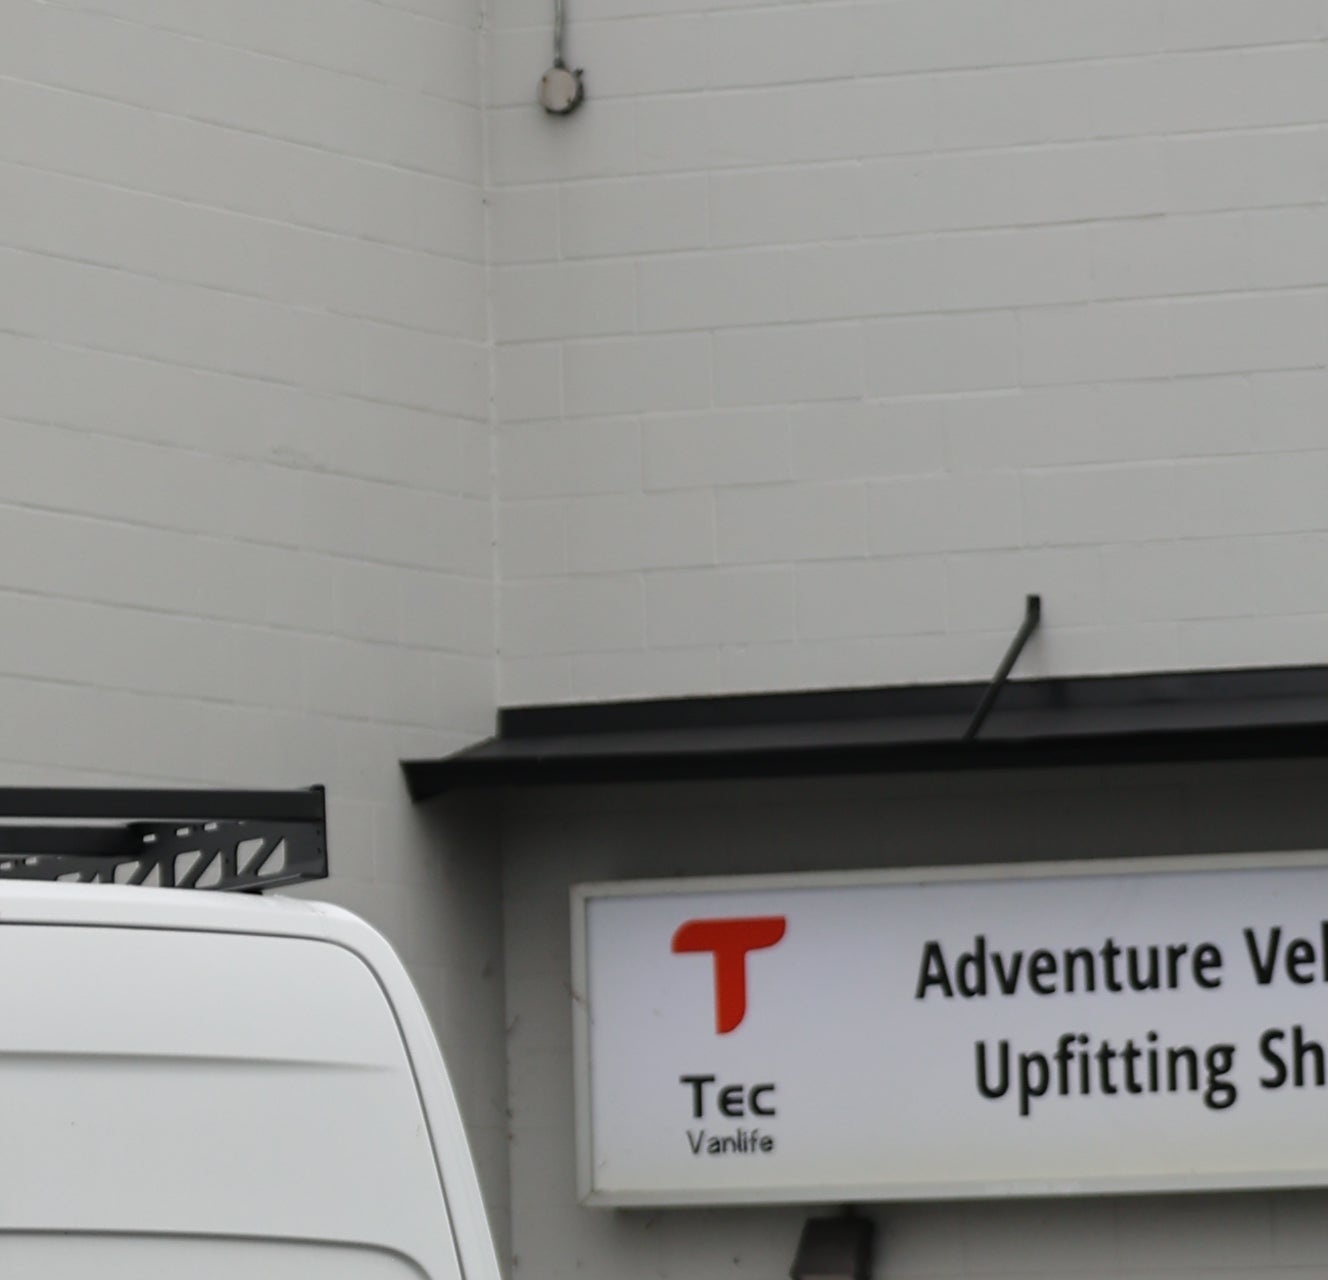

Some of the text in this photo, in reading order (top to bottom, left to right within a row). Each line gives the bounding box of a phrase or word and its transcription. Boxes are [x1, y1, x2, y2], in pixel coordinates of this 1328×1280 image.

[671, 915, 787, 1035] T
[915, 920, 1328, 1000] Adventure Ve
[974, 1030, 1238, 1116] Upfitting
[687, 1130, 775, 1155] Vanlife
